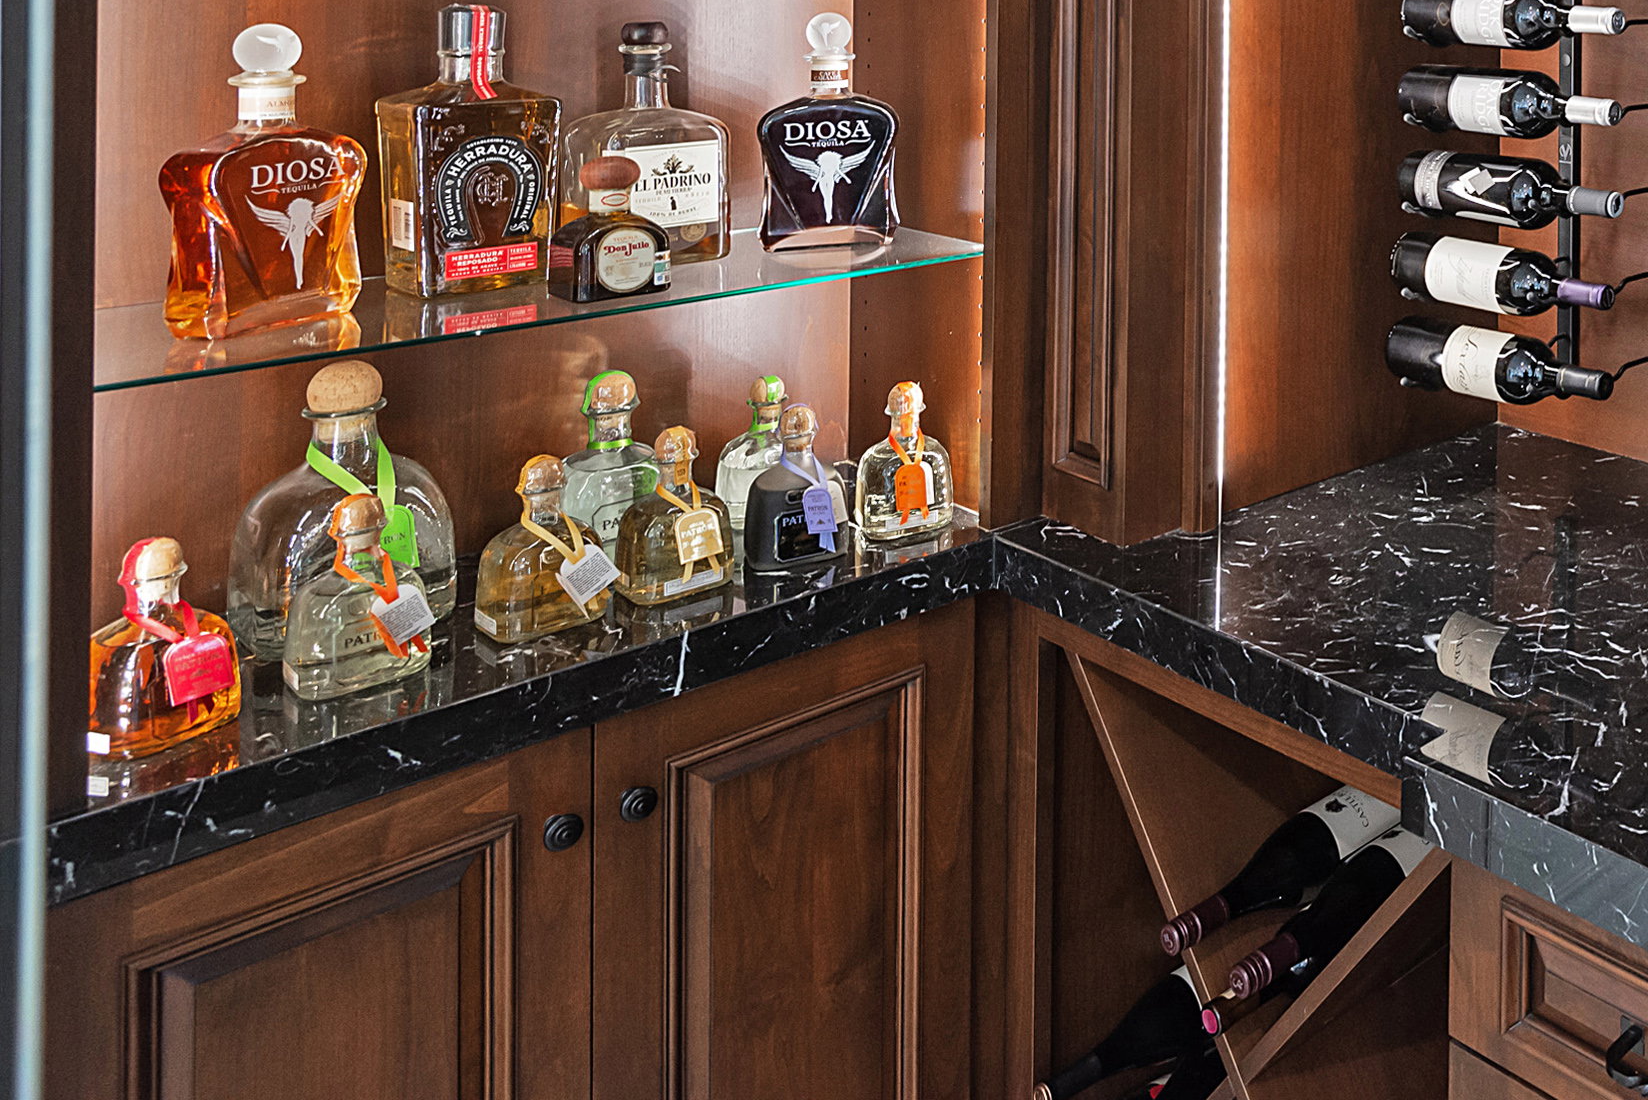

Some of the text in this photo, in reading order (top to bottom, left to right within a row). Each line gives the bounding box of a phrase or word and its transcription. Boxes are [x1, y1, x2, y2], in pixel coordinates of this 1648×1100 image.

[783, 119, 872, 141] DIOSA
[811, 140, 845, 148] TEQUILA
[446, 144, 533, 177] HERRADURA
[250, 156, 345, 191] DIOSA
[634, 172, 711, 192] EL PADRINO
[281, 182, 318, 195] TEQUILA
[444, 188, 458, 225] TEQUILA
[520, 181, 536, 219] ORIGINAL
[451, 250, 504, 262] HERRADURA
[603, 241, 650, 257] Don Julio
[457, 257, 498, 267] REPOSADO
